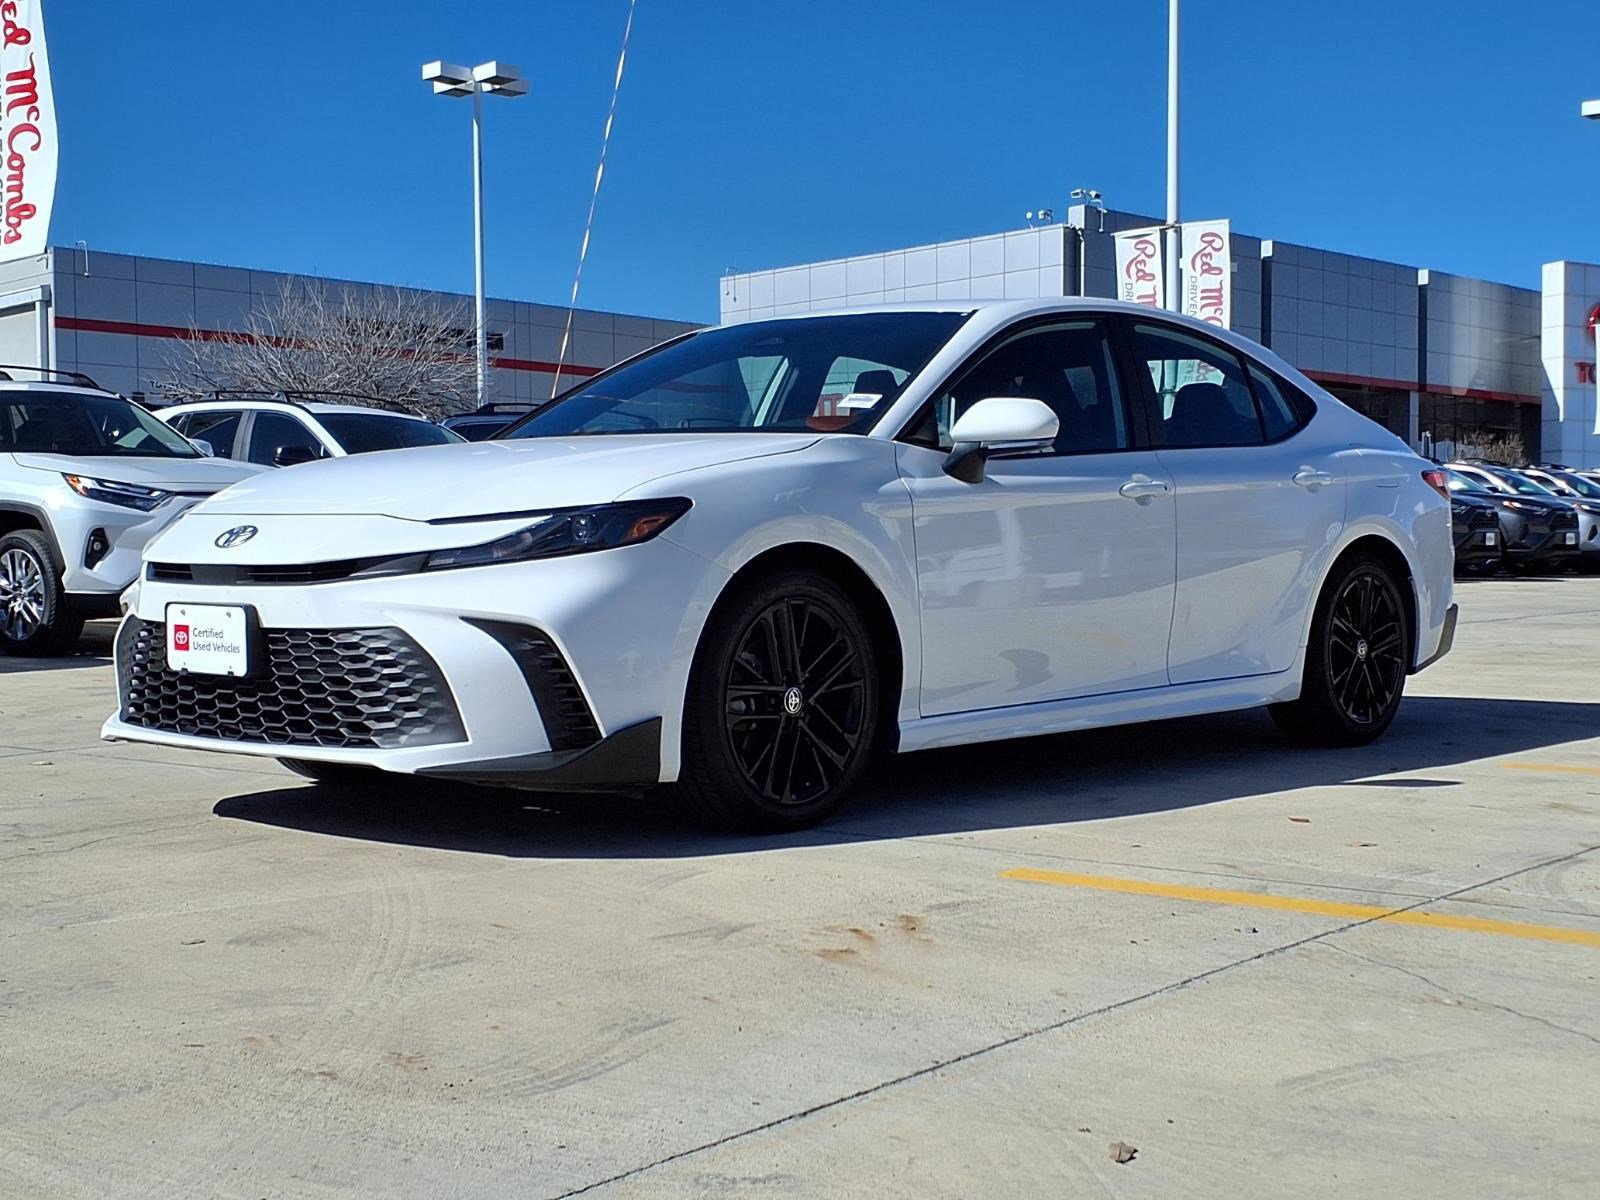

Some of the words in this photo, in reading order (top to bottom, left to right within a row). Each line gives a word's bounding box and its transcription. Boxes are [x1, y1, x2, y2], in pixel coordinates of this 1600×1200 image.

[0, 0, 31, 49] ed
[4, 52, 41, 244] McCombs
[1126, 239, 1156, 283] Red
[1191, 232, 1224, 277] Red
[193, 627, 223, 639] Certified
[193, 641, 211, 651] Used
[212, 642, 240, 653] Vehicles
